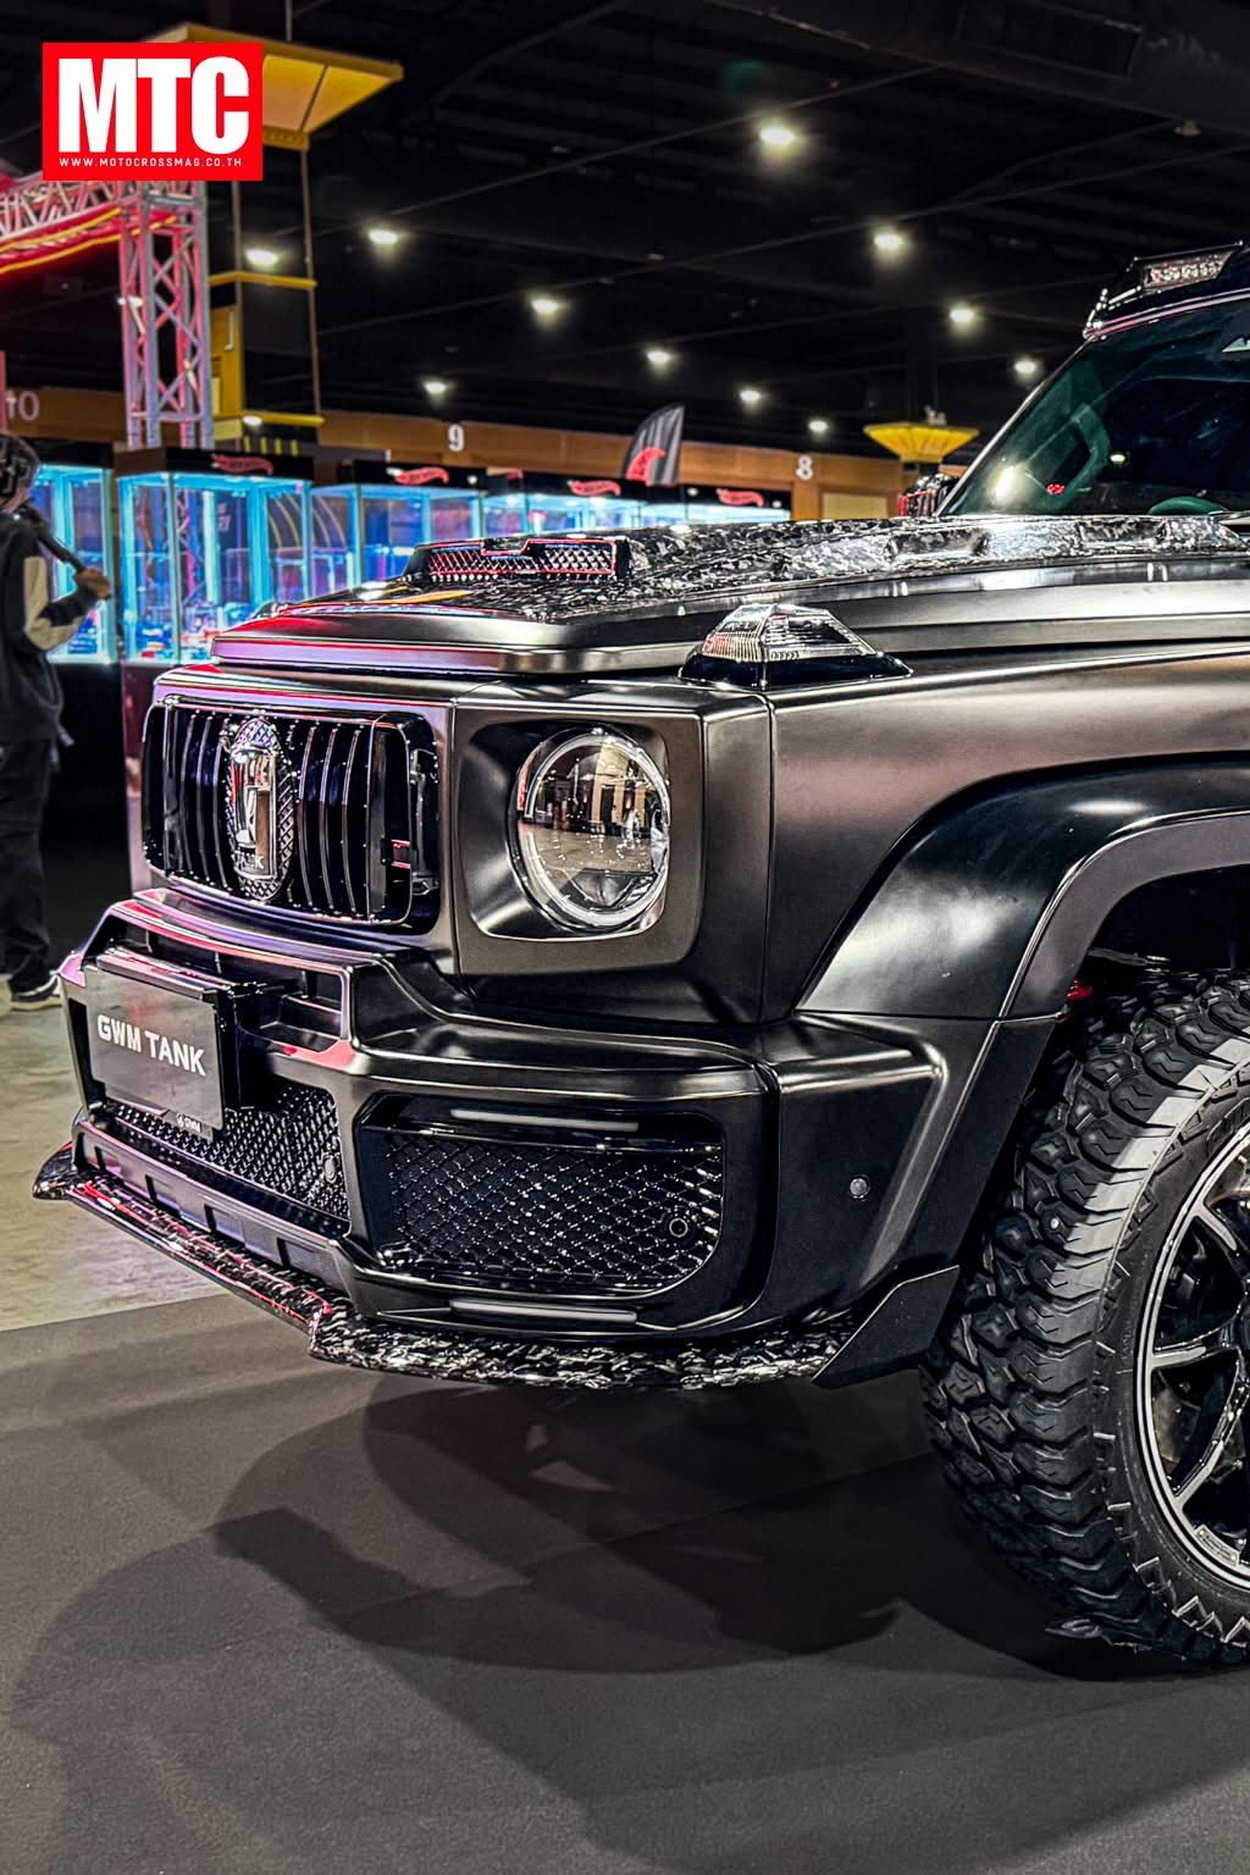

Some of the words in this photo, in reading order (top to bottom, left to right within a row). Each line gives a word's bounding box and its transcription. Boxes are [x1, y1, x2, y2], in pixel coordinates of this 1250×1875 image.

[448, 424, 465, 452] 9
[795, 454, 814, 481] 8
[96, 1013, 142, 1054] GWM
[144, 1030, 206, 1077] TANK
